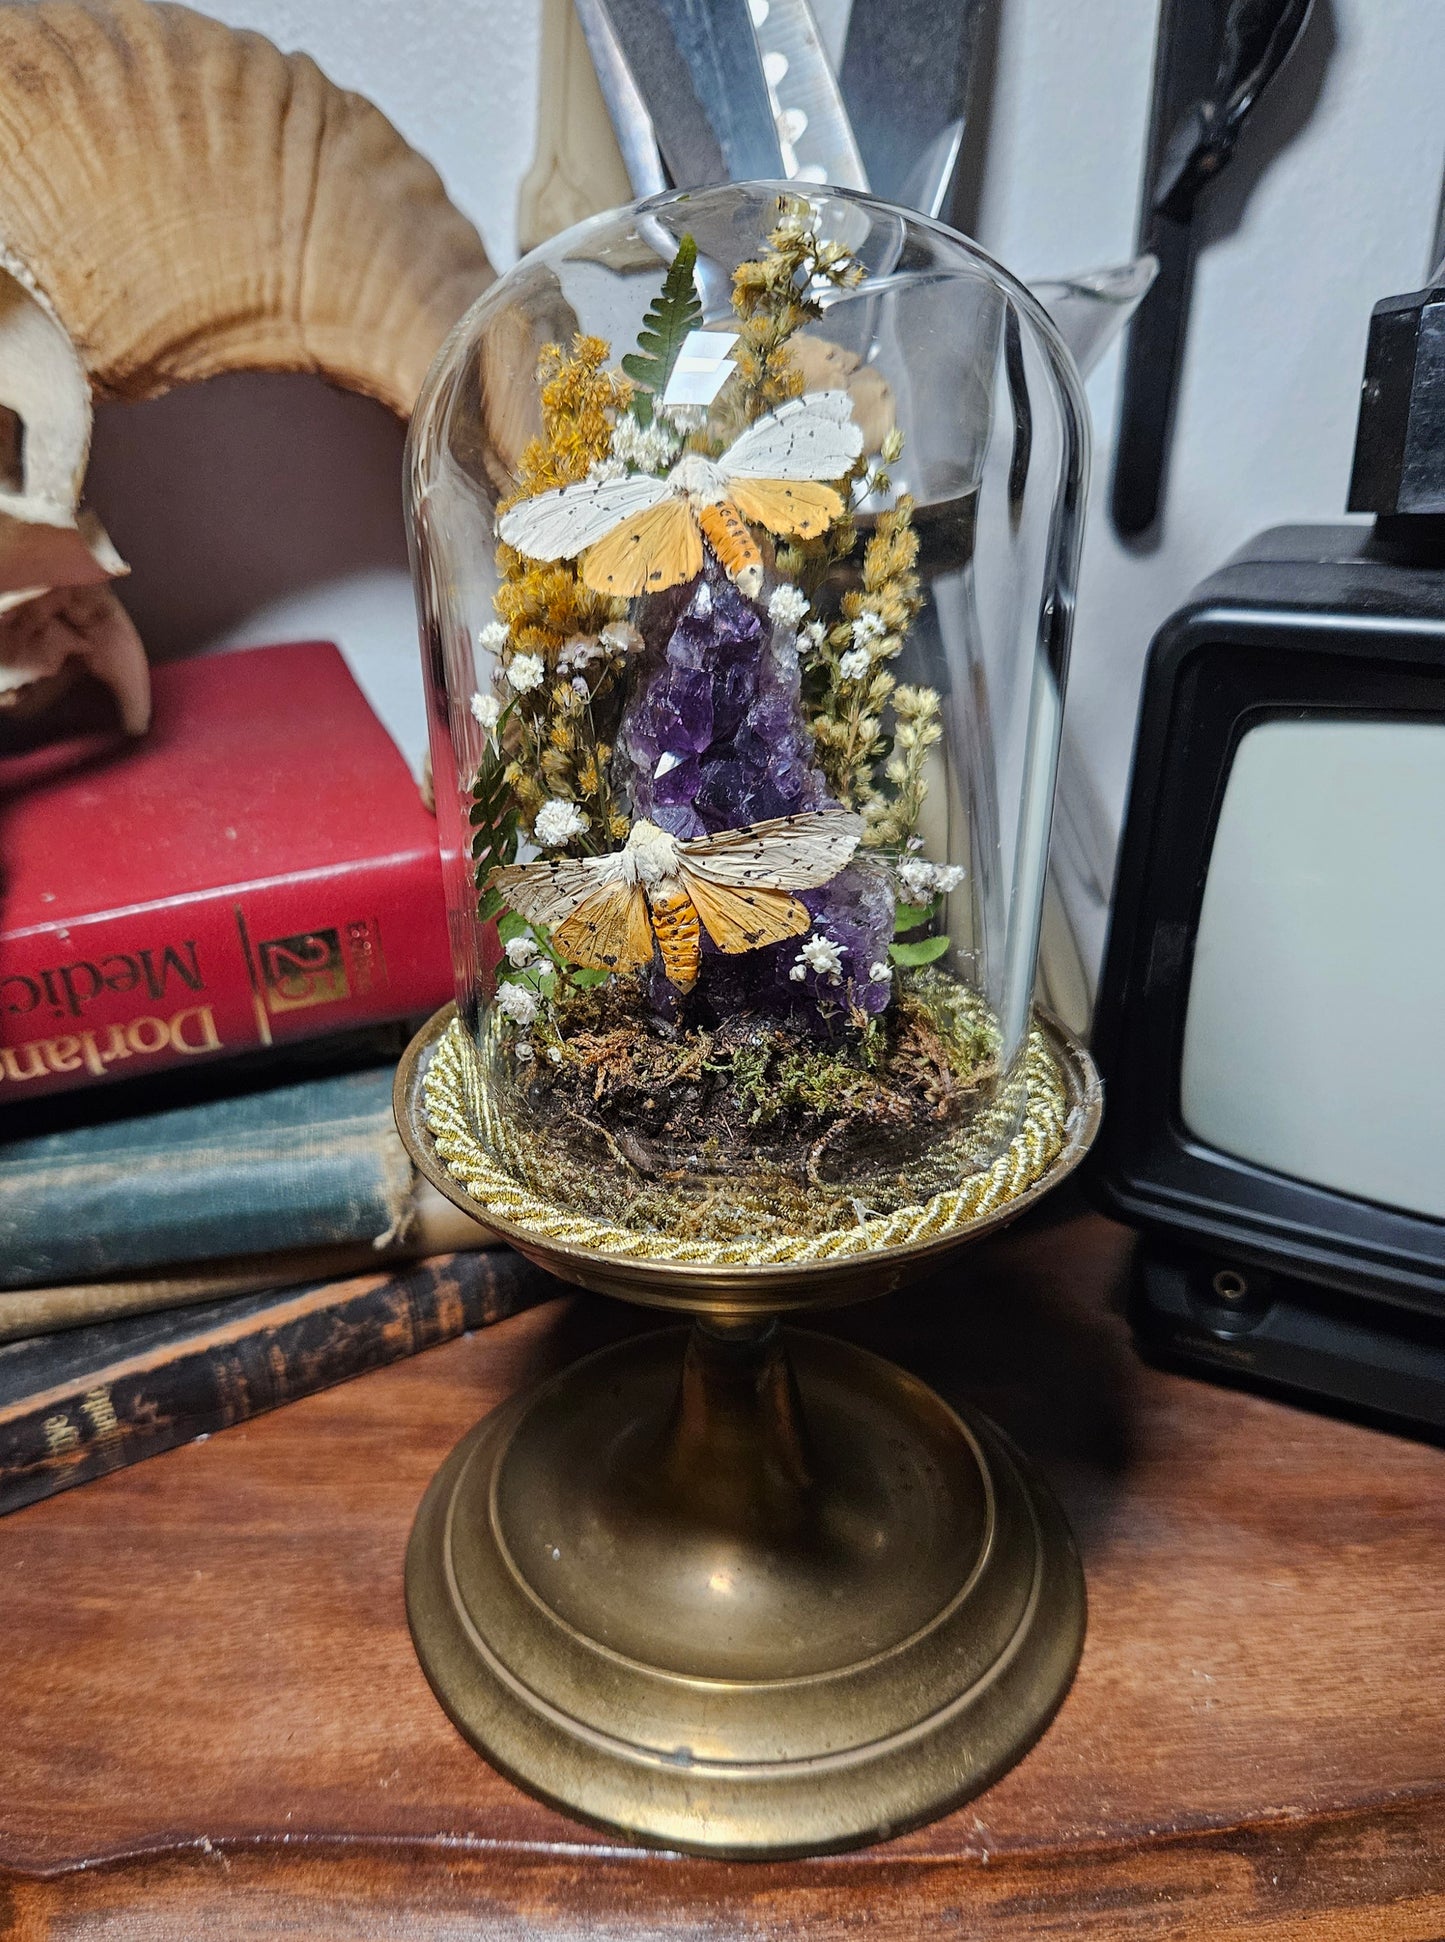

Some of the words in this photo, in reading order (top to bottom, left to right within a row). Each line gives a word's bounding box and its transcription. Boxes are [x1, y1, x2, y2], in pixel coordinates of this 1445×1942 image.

[0, 941, 205, 1018] Medic
[268, 936, 336, 1000] 25
[0, 1004, 224, 1082] Dorlan
